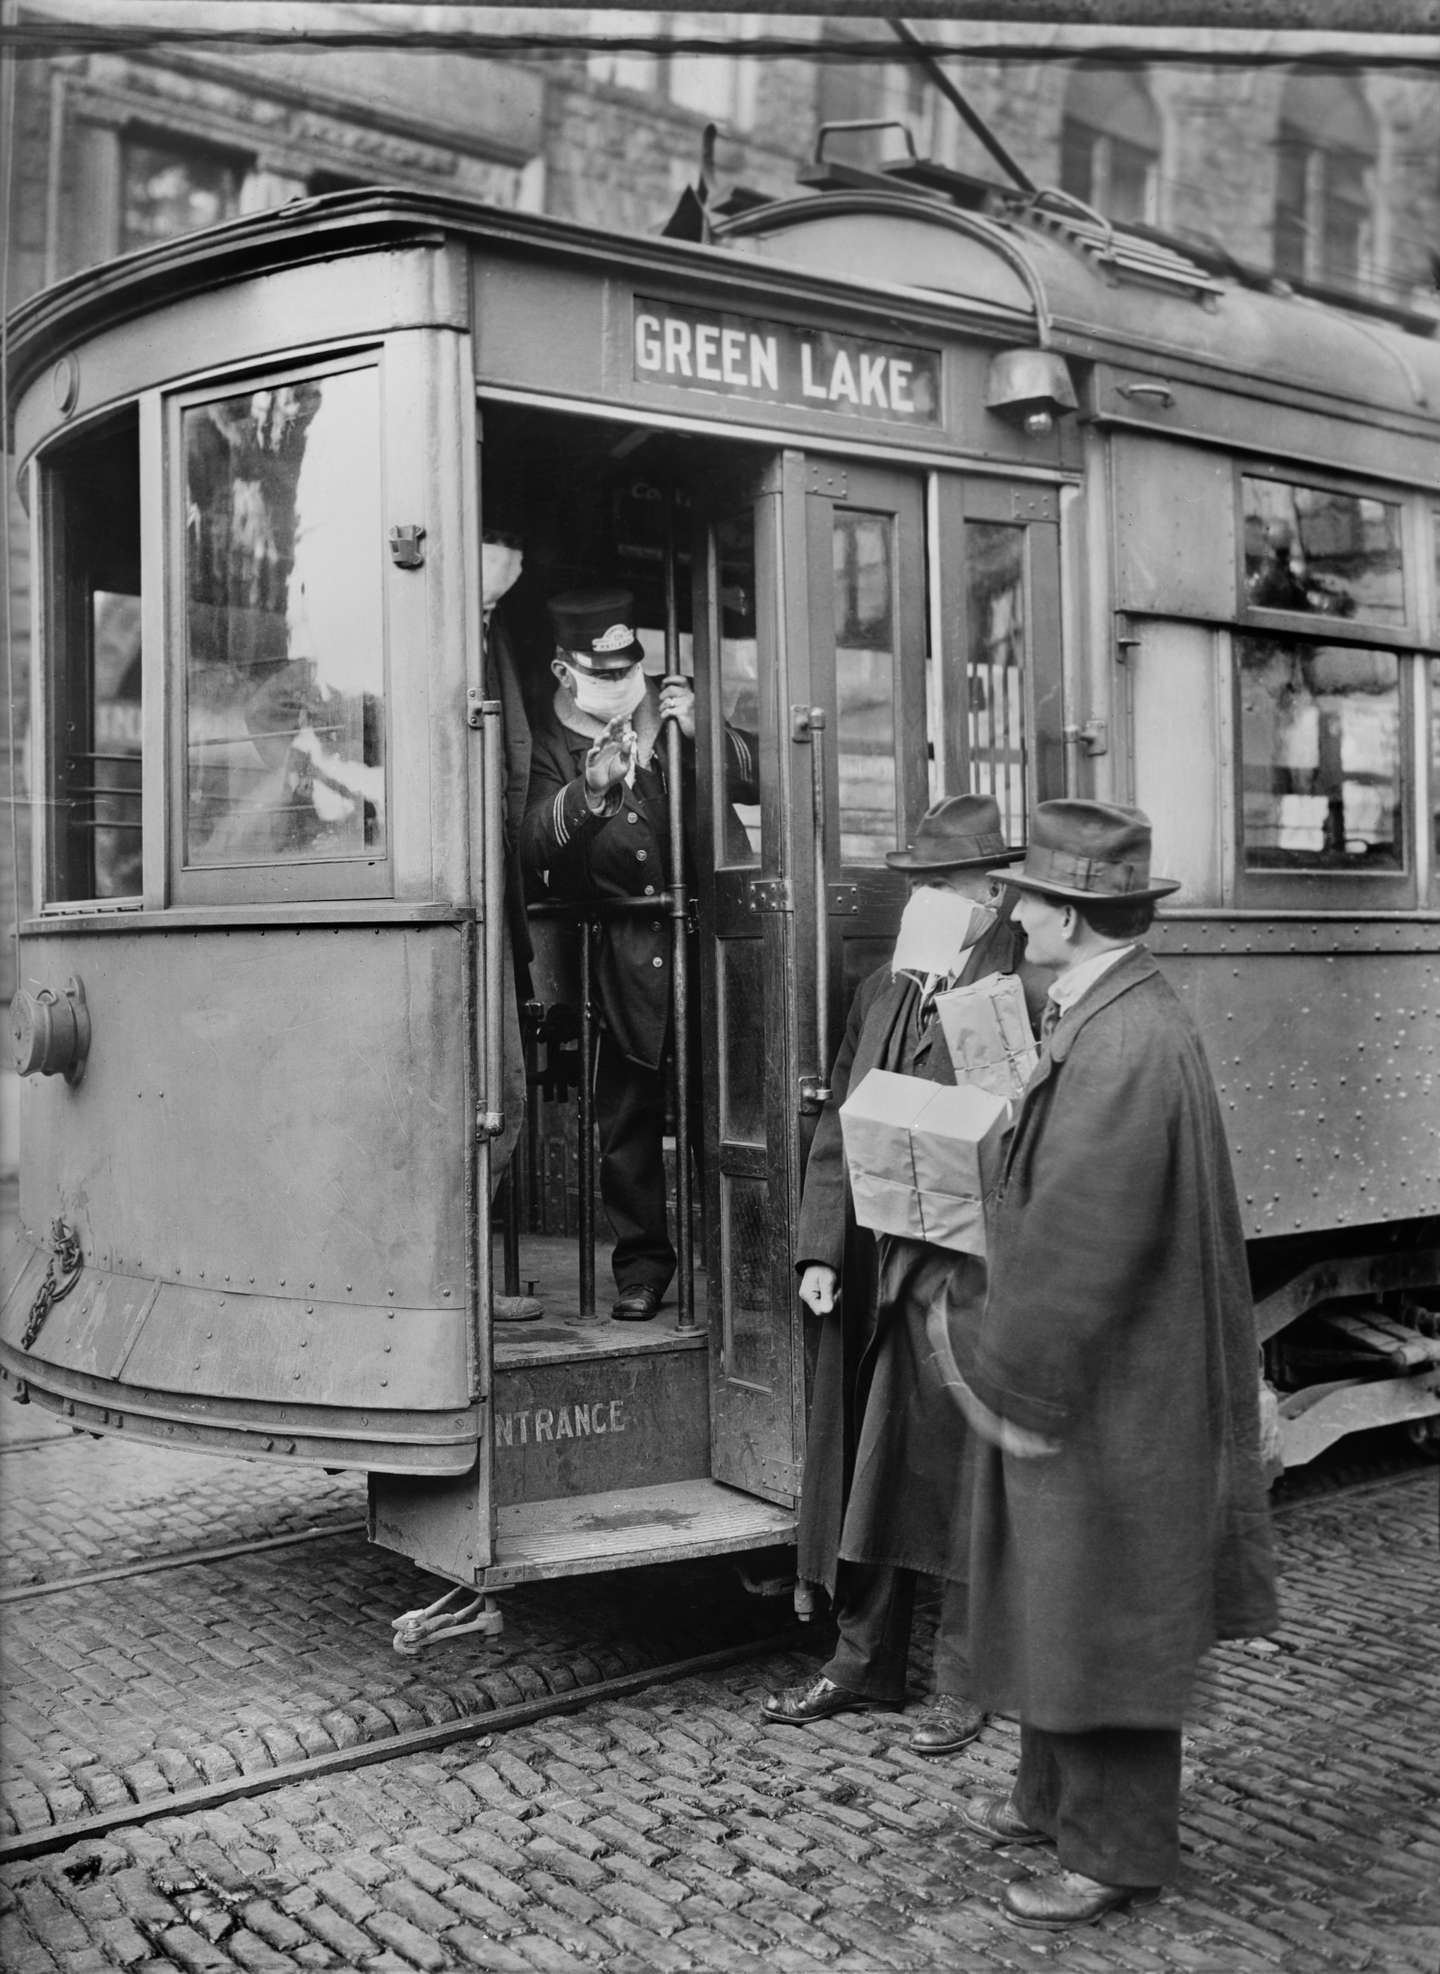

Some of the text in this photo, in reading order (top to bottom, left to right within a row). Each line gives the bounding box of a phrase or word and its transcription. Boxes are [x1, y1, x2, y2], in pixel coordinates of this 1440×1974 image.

[635, 314, 915, 413] GREEN LAKE
[494, 1399, 625, 1447] NTRANCE
